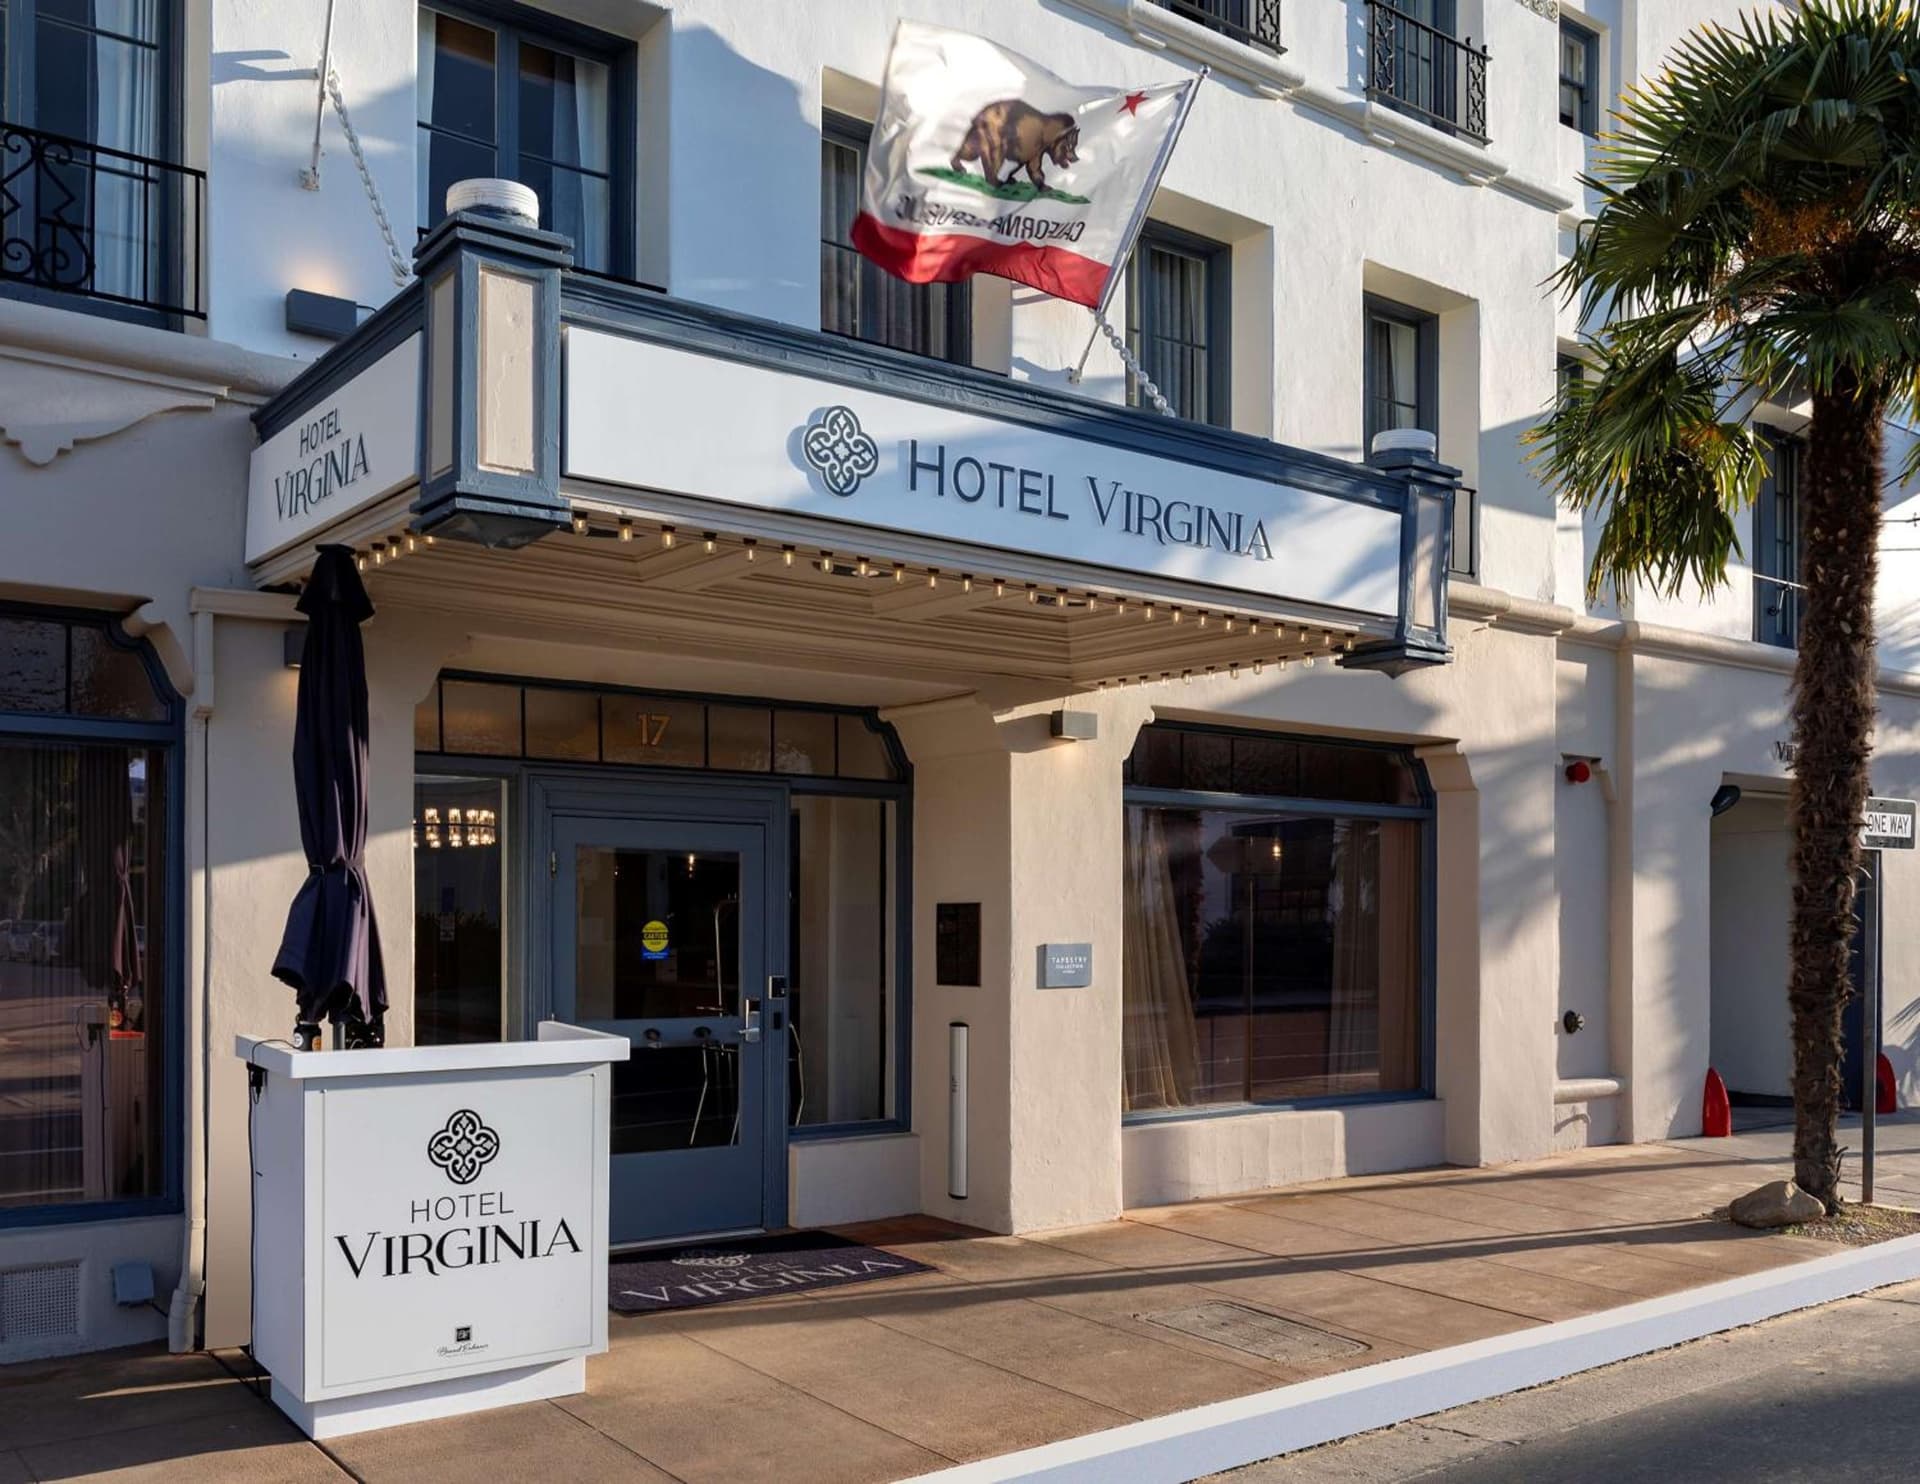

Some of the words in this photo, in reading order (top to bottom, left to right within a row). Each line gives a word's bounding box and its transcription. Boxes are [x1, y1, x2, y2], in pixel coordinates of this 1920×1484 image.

[300, 408, 342, 458] HOTEL
[275, 432, 369, 521] VIRGINIA
[909, 439, 1069, 521] HOTEL
[1086, 476, 1274, 560] VIRGINIA
[639, 713, 672, 746] 17
[1867, 814, 1887, 833] ONE
[1889, 815, 1910, 835] WAY
[411, 1191, 514, 1224] HOTEL
[333, 1217, 584, 1280] VIRGINIA
[620, 1259, 905, 1302] VIRGINIA
[687, 1261, 805, 1282] HOTEL
